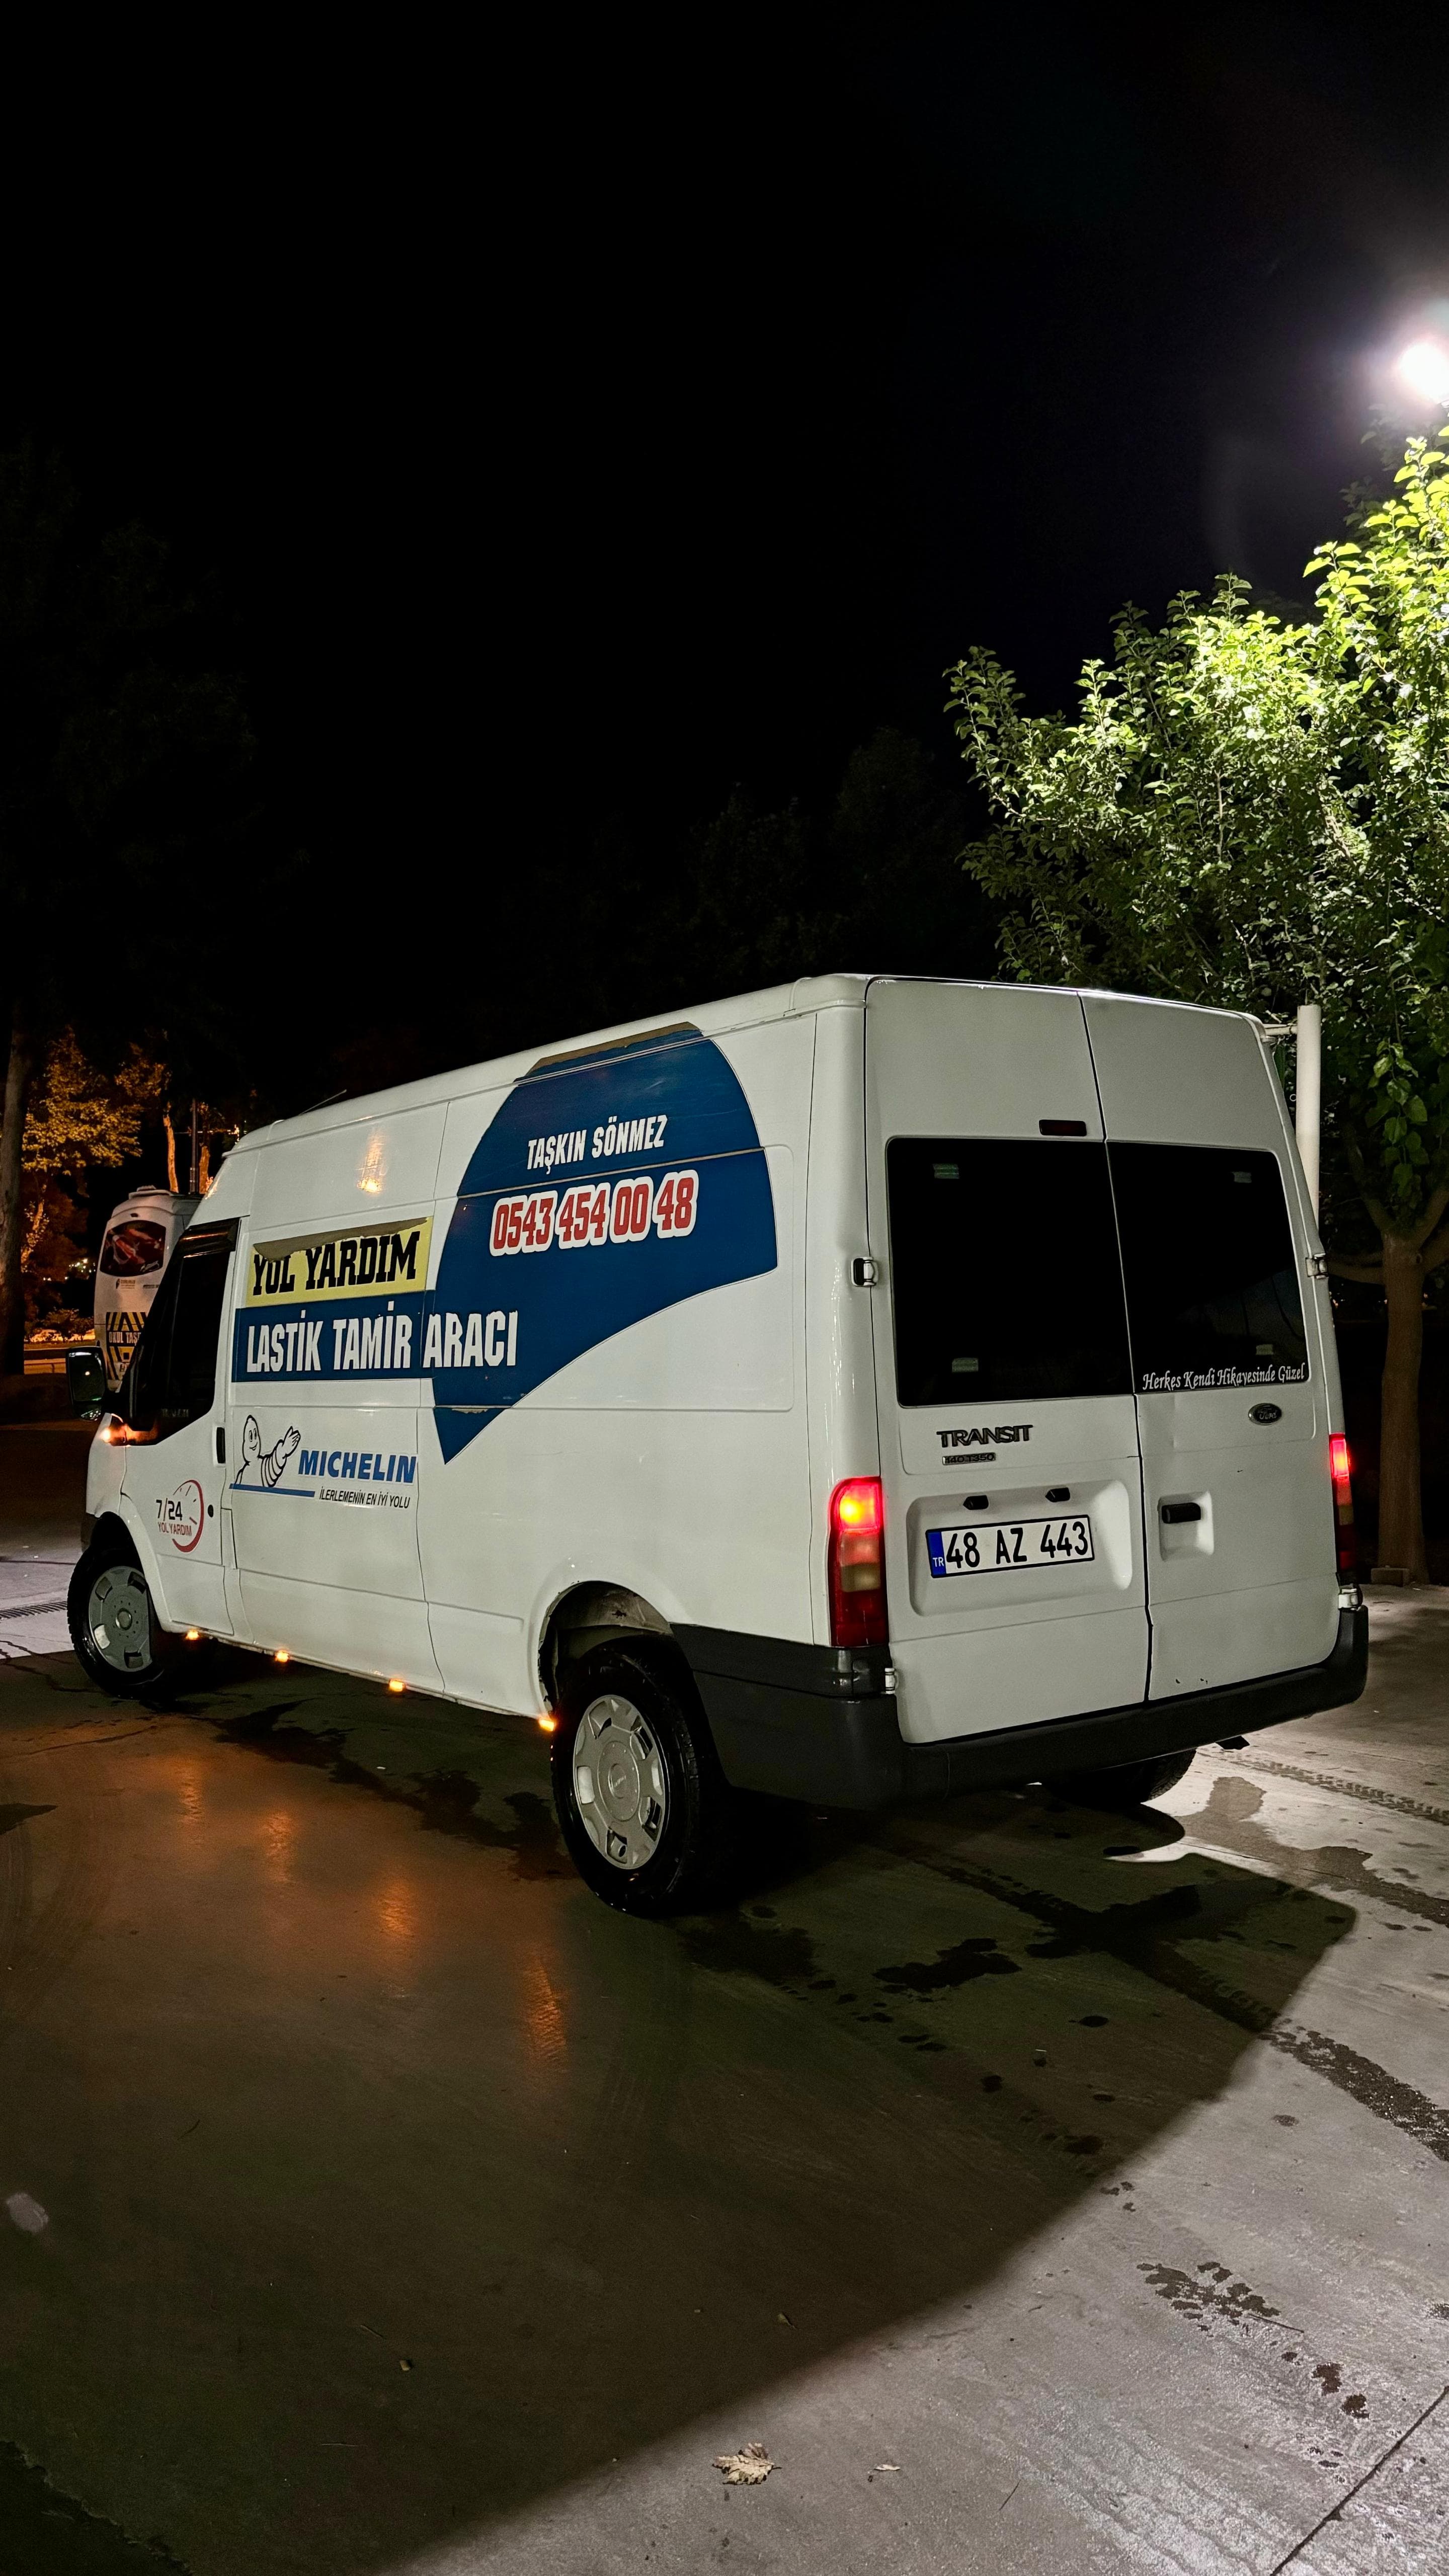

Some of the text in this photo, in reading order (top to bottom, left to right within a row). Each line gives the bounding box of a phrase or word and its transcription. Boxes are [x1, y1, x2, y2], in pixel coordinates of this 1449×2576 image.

[527, 1114, 668, 1174] TAŞKIN SÖNMEZ
[493, 1177, 694, 1250] 0543 454 00 48
[253, 1231, 420, 1296] YOL YARDIM
[109, 1331, 124, 1343] OKUL
[247, 1301, 518, 1373] LASTİK TAMİR ARACI
[1143, 1362, 1306, 1391] Herkes Kendi Hikayesinde Güzel
[936, 1425, 1033, 1447] TRANSIT
[298, 1450, 417, 1483] MICHELIN
[156, 1498, 182, 1521] 7/24
[319, 1486, 411, 1508] İLERLEMENİN EN İYİ YOLU
[157, 1522, 192, 1536] YOL YARDIM
[946, 1521, 1088, 1568] 48 AZ 443
[932, 1557, 944, 1567] TR
